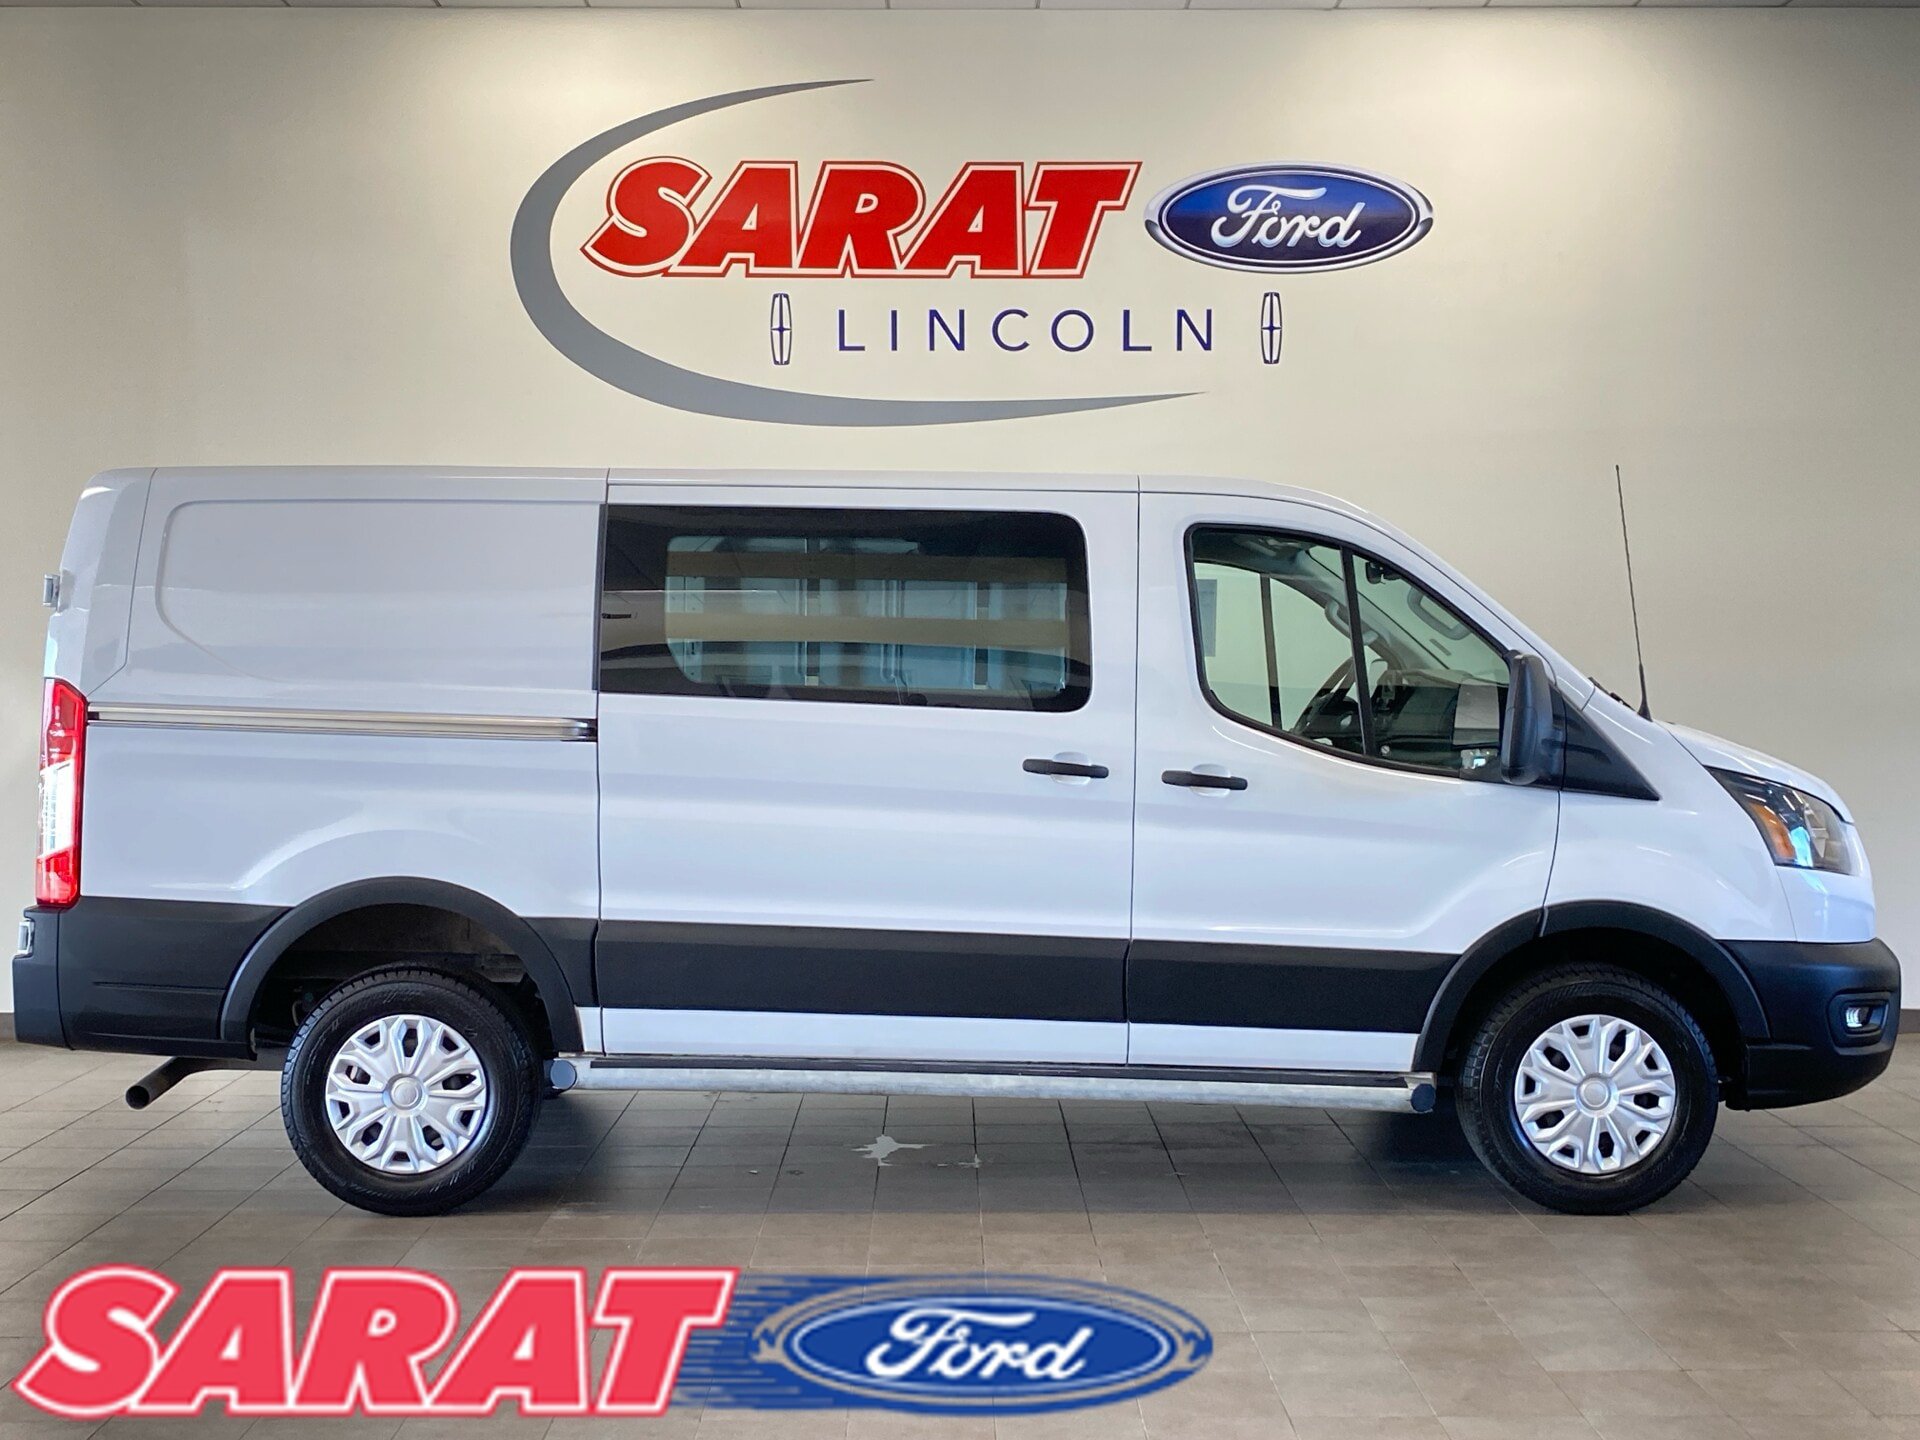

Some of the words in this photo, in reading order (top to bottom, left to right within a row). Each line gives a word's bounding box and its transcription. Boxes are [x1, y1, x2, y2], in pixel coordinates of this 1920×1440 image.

[581, 156, 1141, 278] SARAT
[1211, 186, 1362, 249] Ford
[837, 308, 1212, 352] LINCOLN
